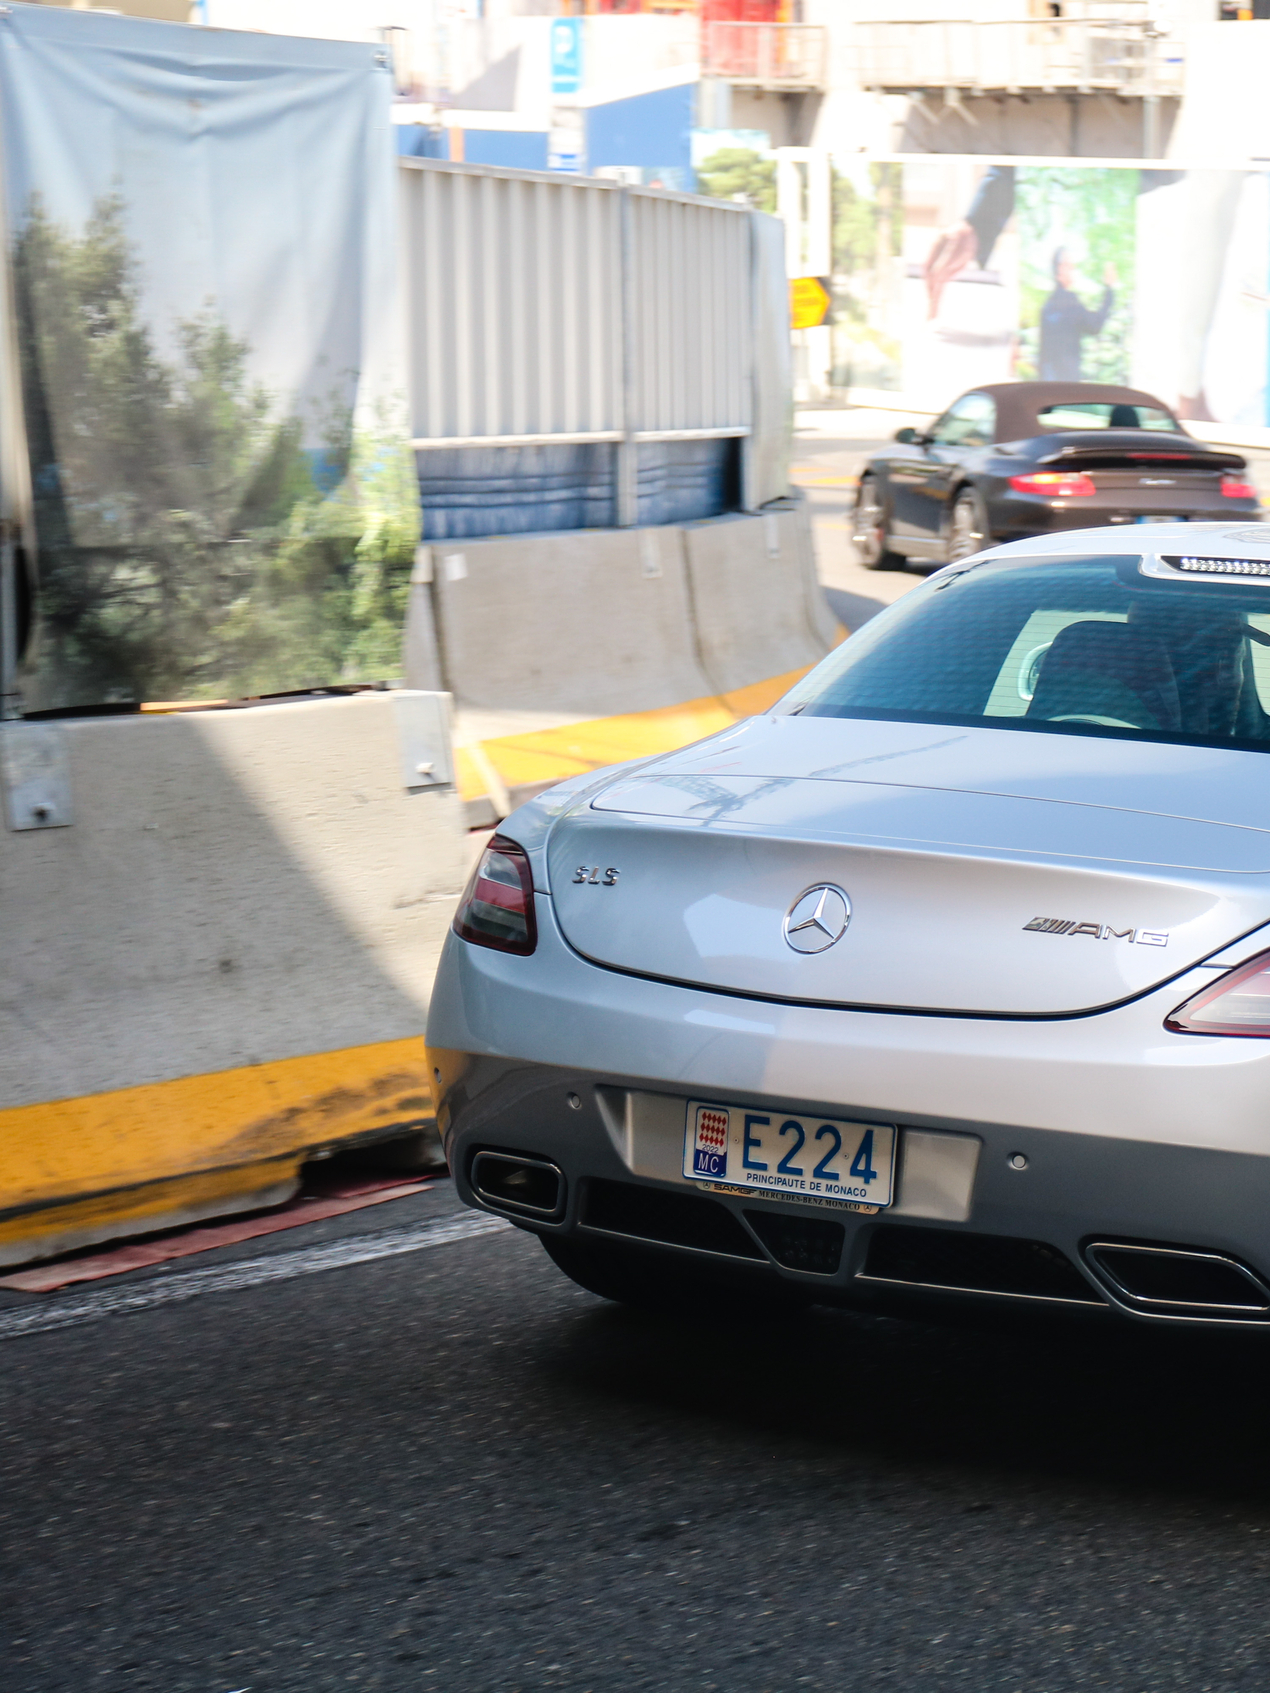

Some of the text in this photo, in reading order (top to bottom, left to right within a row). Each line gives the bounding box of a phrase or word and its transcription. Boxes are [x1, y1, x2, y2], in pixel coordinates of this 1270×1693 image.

[571, 865, 621, 886] SLS
[1067, 921, 1170, 947] AMG
[701, 1143, 719, 1154] 2022
[742, 1114, 877, 1185] E224
[697, 1153, 719, 1173] MC
[746, 1172, 867, 1198] PRINCIPAUTE DE MONACO
[758, 1190, 824, 1206] MERCEDES-BENZ
[824, 1199, 861, 1211] MONACO
